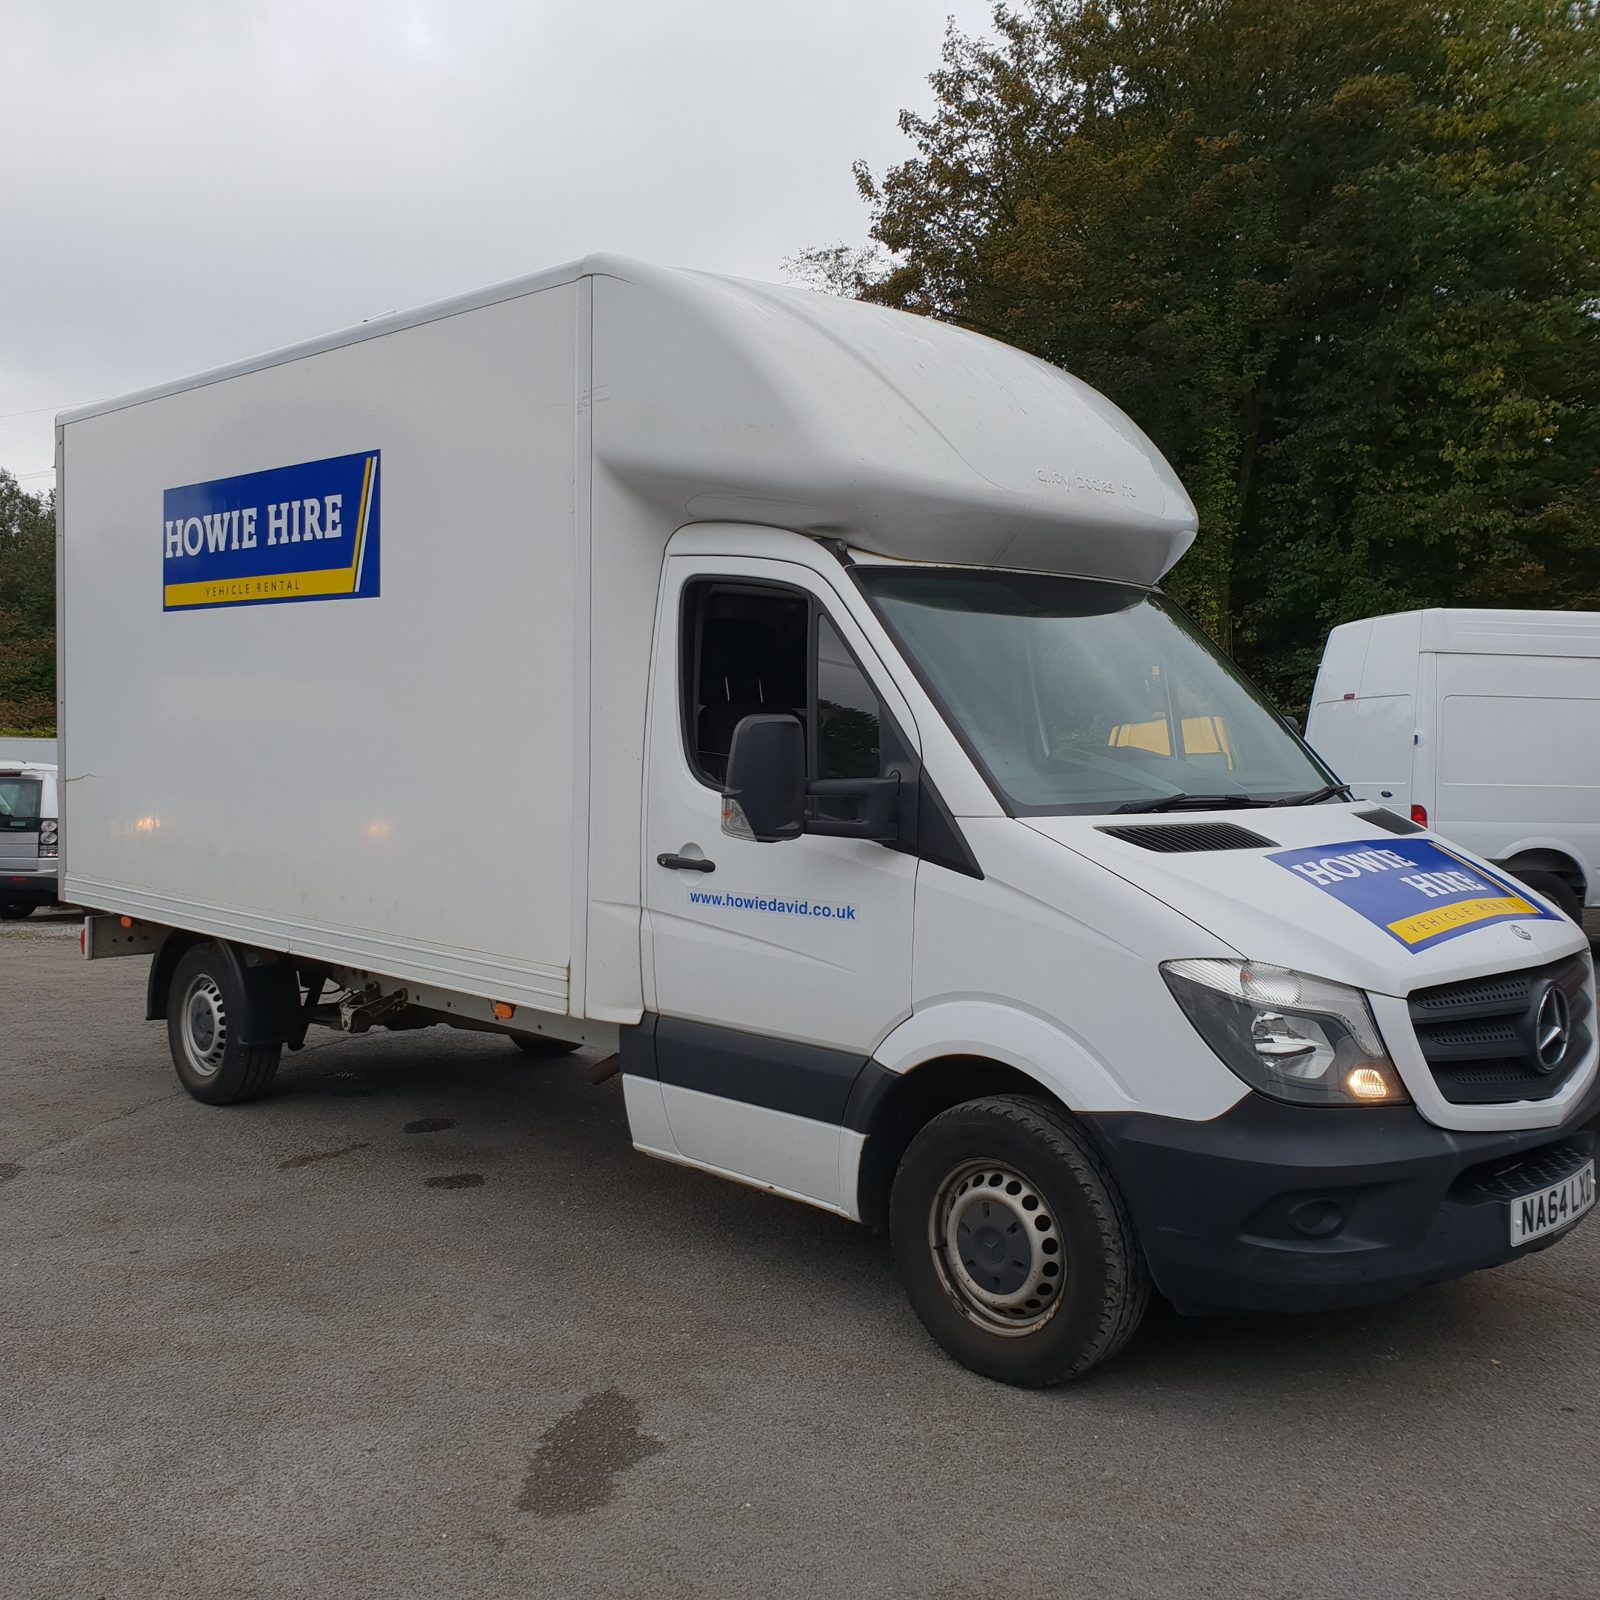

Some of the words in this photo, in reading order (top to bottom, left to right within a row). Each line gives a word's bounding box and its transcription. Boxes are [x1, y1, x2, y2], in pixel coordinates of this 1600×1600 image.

[165, 507, 257, 558] HOWIE
[267, 494, 342, 545] HIRE
[205, 584, 250, 597] VEHICLE
[257, 580, 300, 593] RENTAL
[1291, 849, 1418, 885] HOWIE
[1400, 871, 1488, 898] HIRE
[690, 892, 856, 920] www.howiedavid.co.uk
[1406, 907, 1473, 933] VEHICLE
[1478, 898, 1526, 912] RENTAL
[1522, 1185, 1567, 1235] NA64
[1571, 1168, 1591, 1213] LXD
